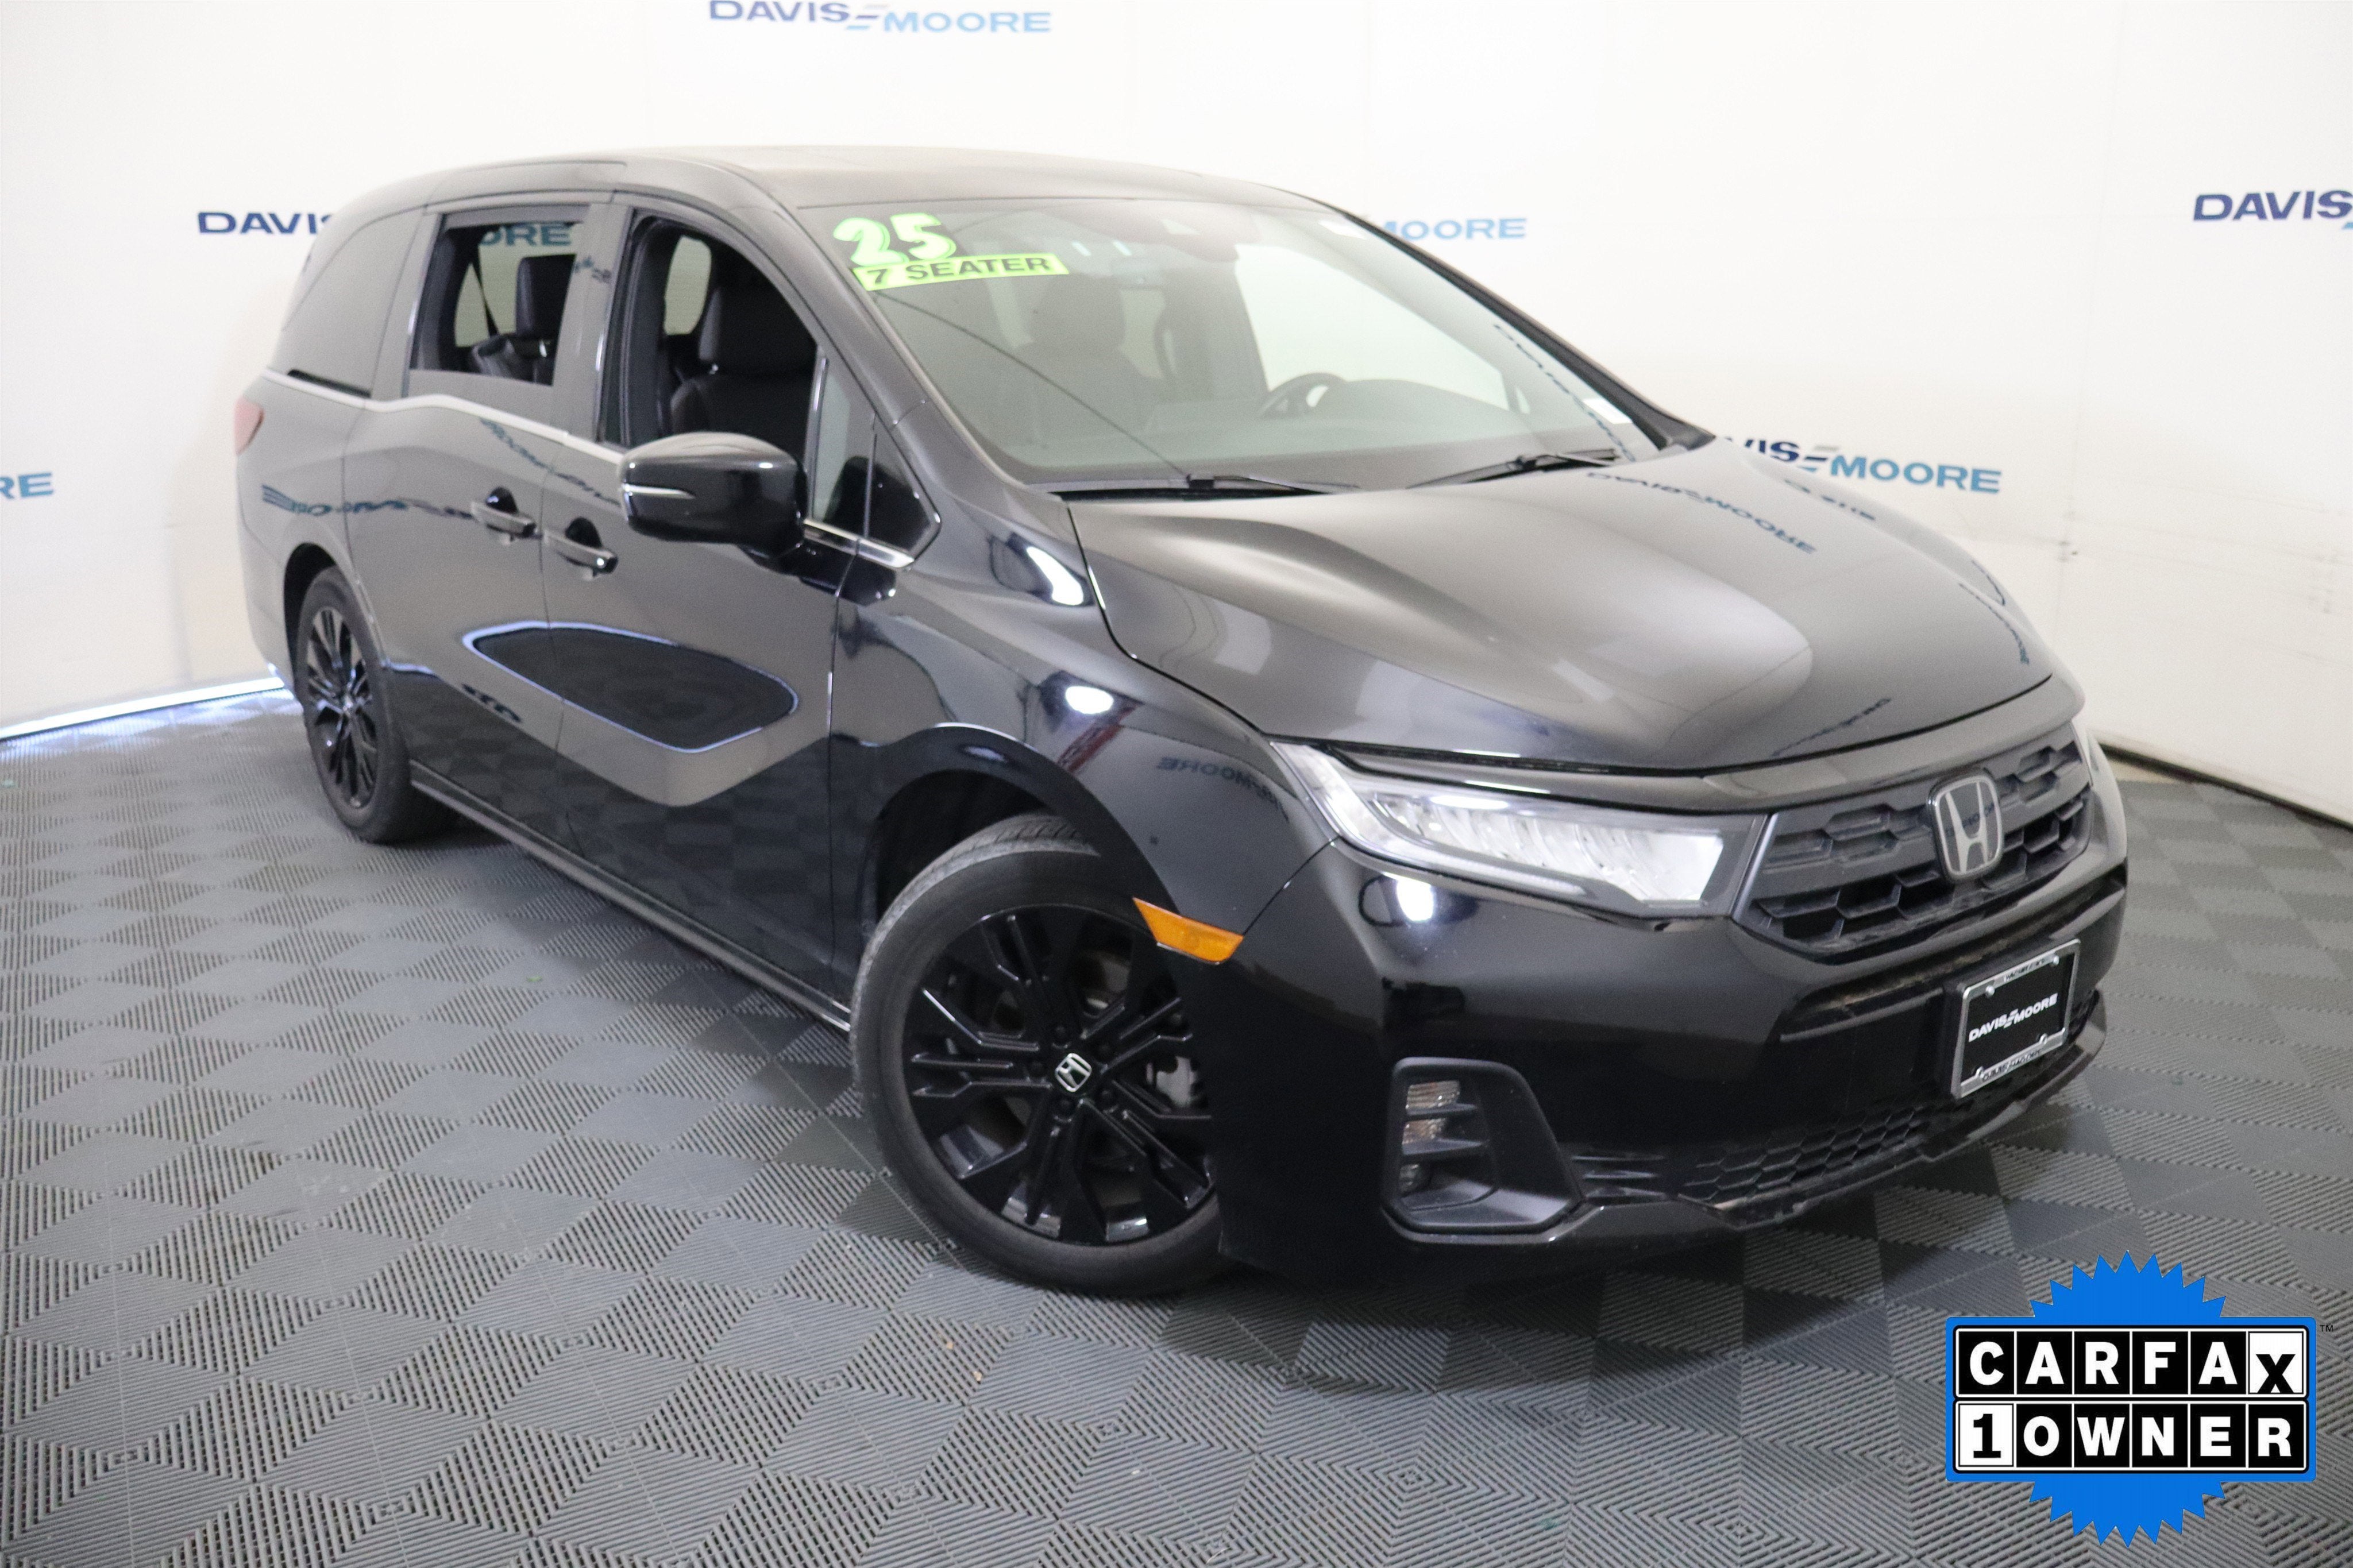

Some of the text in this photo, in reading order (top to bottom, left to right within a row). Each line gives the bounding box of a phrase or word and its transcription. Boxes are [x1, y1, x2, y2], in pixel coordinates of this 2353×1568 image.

[709, 0, 1051, 33] DAVIS MOORE
[2192, 190, 2353, 220] DAVIS
[198, 212, 331, 234] DAVI
[833, 213, 957, 267] 25
[867, 257, 1051, 285] 7 SEATER
[1830, 455, 2002, 495] MOORE
[1968, 992, 2058, 1042] DAVIS MOORE
